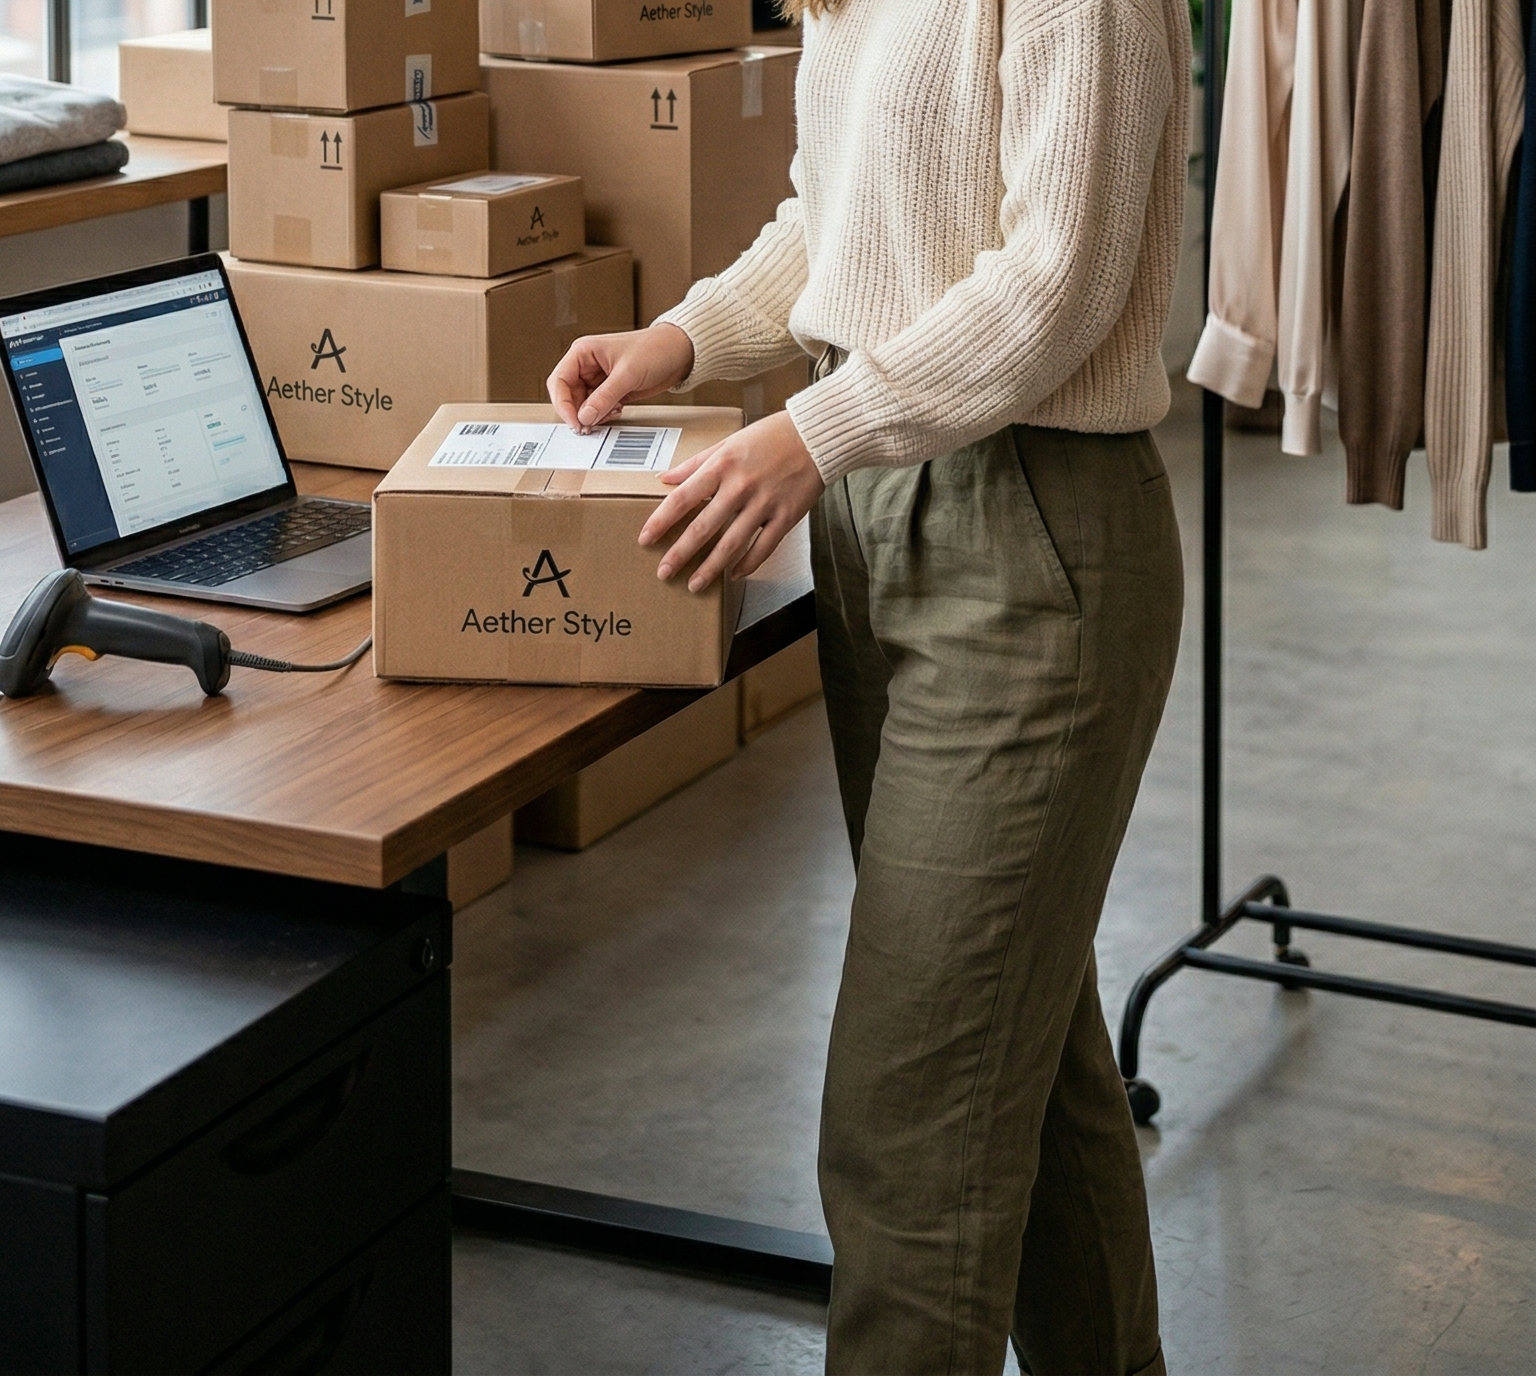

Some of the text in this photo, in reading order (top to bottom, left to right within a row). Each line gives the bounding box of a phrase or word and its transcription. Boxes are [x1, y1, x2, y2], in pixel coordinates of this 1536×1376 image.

[640, 0, 713, 22] Aether Style
[266, 375, 393, 414] Aether Style
[461, 608, 632, 643] Aether Style
